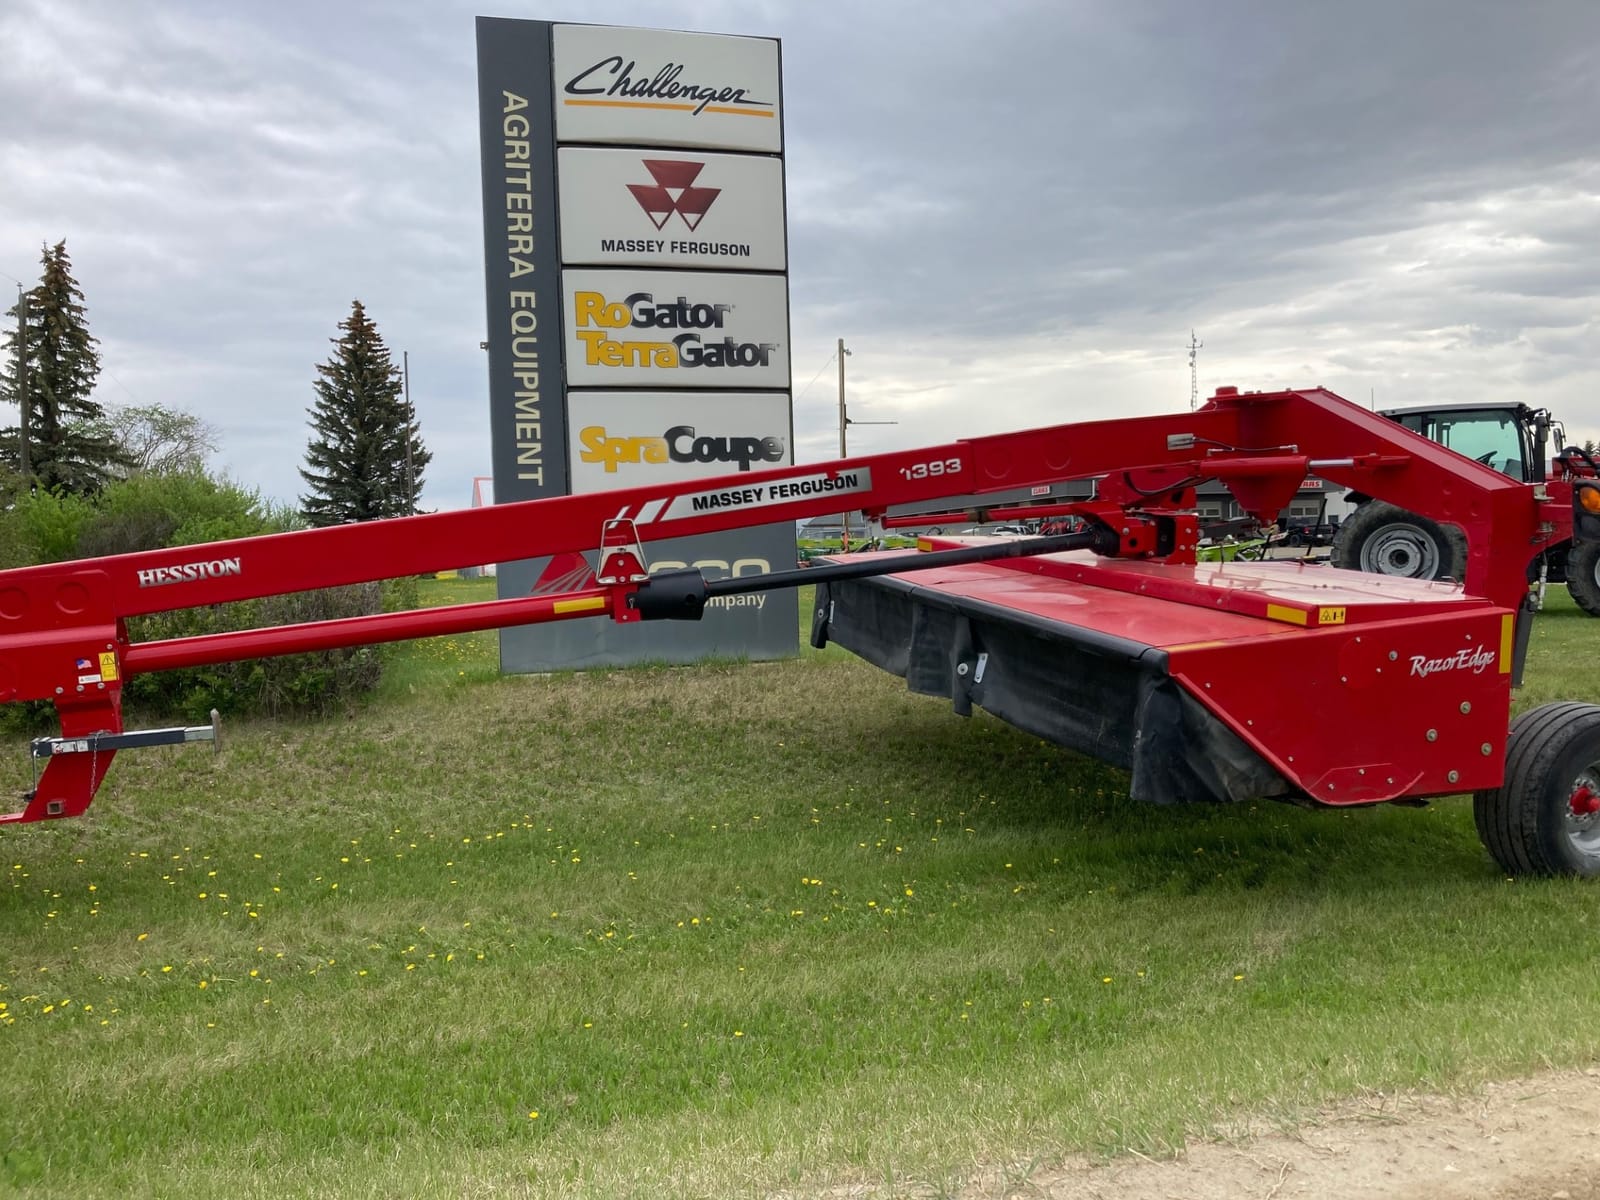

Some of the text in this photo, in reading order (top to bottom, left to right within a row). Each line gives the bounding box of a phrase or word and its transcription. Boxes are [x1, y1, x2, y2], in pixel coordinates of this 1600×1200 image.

[564, 56, 774, 116] Challenger
[601, 240, 750, 256] MASSEY FERGUSON
[503, 90, 543, 486] AGRITERRA EQUIPMENT
[574, 291, 730, 328] RoGator
[576, 331, 775, 368] TerraGator
[580, 425, 785, 473] SpraCoupe
[900, 458, 962, 480] 1393
[692, 474, 858, 511] MASSEY FERGUSON
[137, 557, 241, 588] HESSTON
[1409, 644, 1495, 678] RazorEdge
